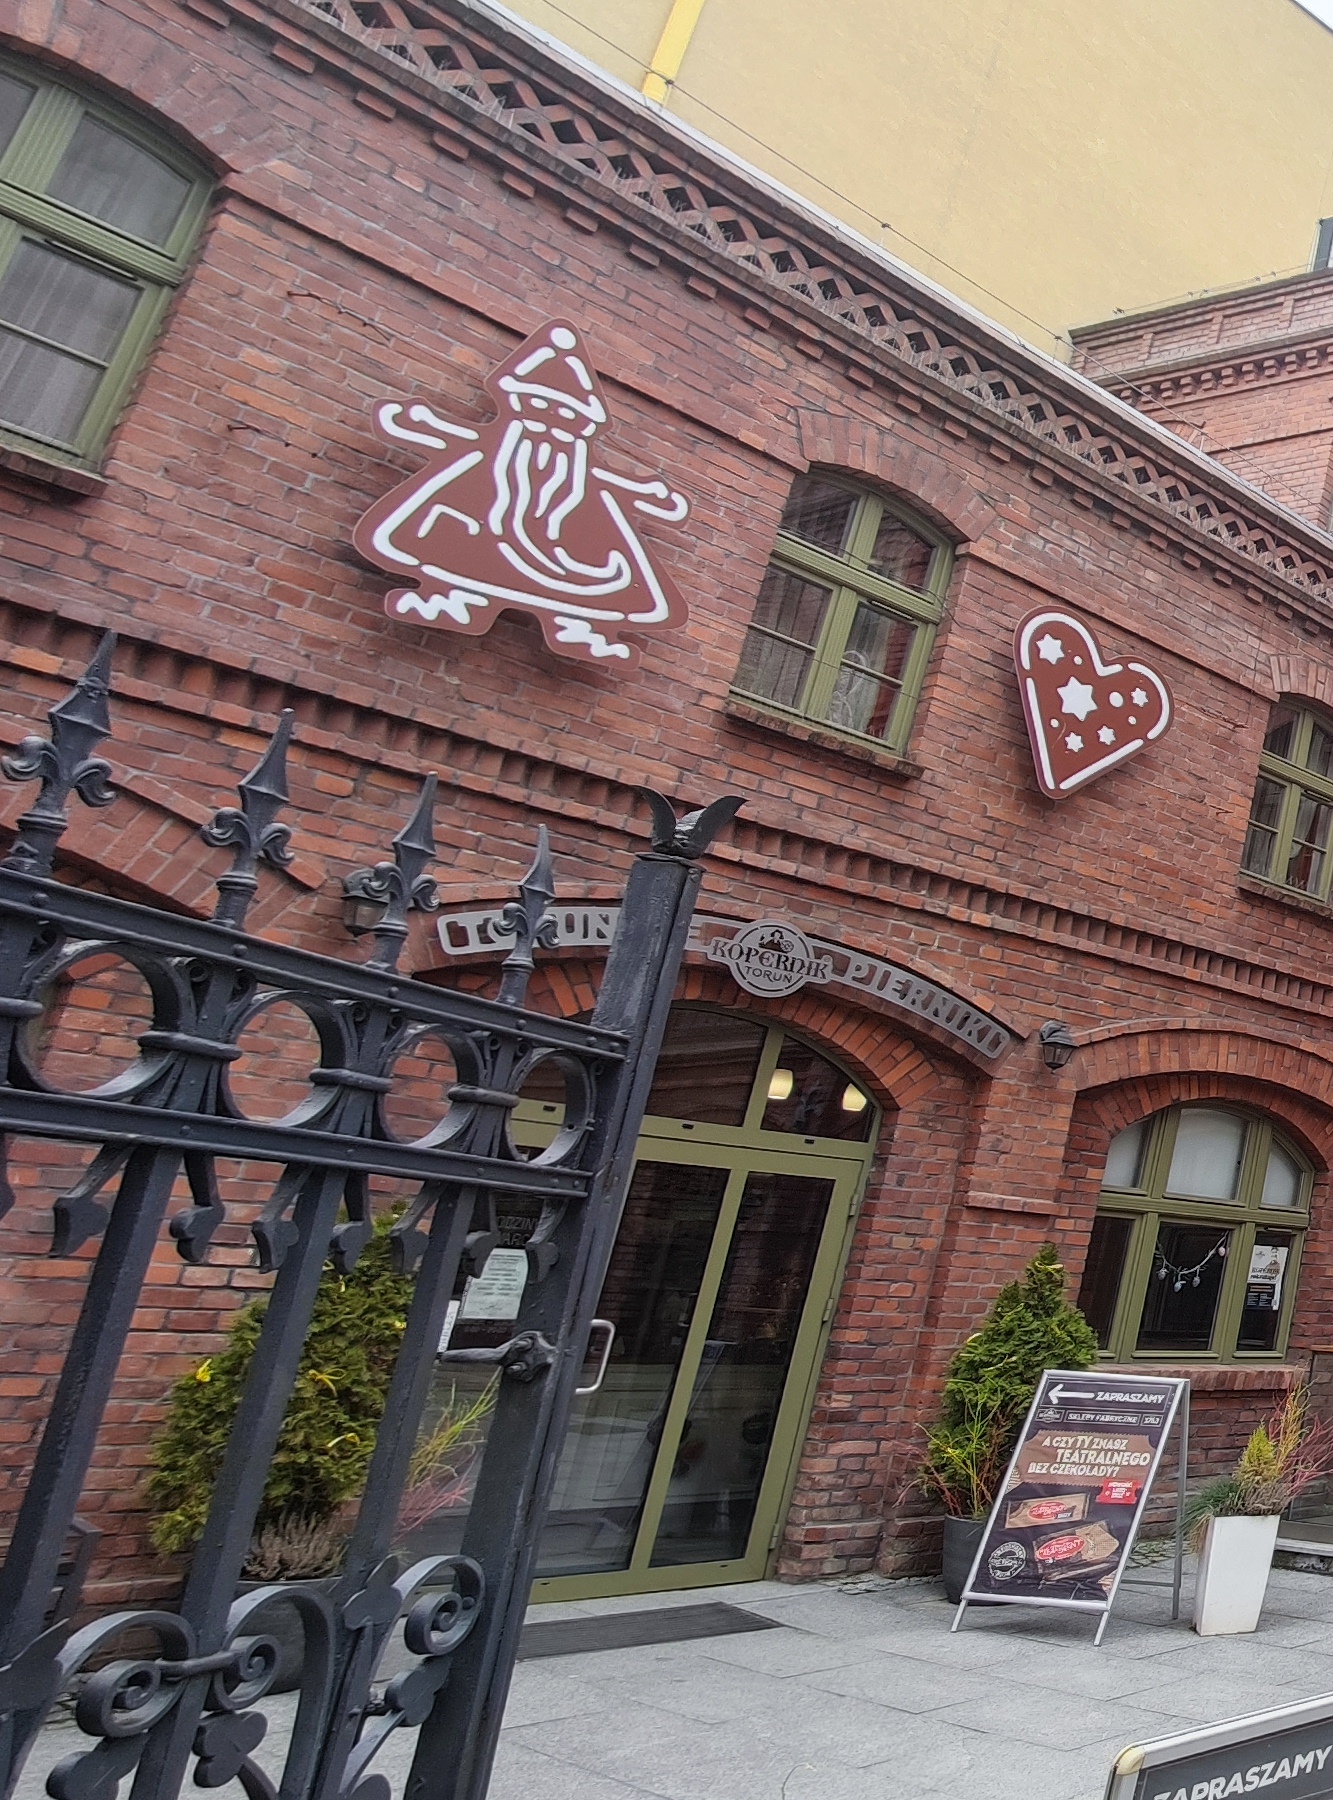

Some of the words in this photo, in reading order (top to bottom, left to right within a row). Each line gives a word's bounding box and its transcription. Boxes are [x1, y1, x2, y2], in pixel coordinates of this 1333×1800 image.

[712, 939, 828, 979] KOPERNIK
[850, 954, 999, 1050] PIERNIKI
[1095, 1391, 1166, 1404] ZAPRASZAMY
[1042, 1436, 1051, 1447] A
[1052, 1436, 1076, 1448] CZY
[1076, 1435, 1093, 1448] TY
[1091, 1438, 1128, 1450] ZNASZ
[1056, 1449, 1150, 1466] TEATRALNEGO
[1027, 1462, 1050, 1474] BEZ
[1050, 1464, 1121, 1477] CZEKOLADY?
